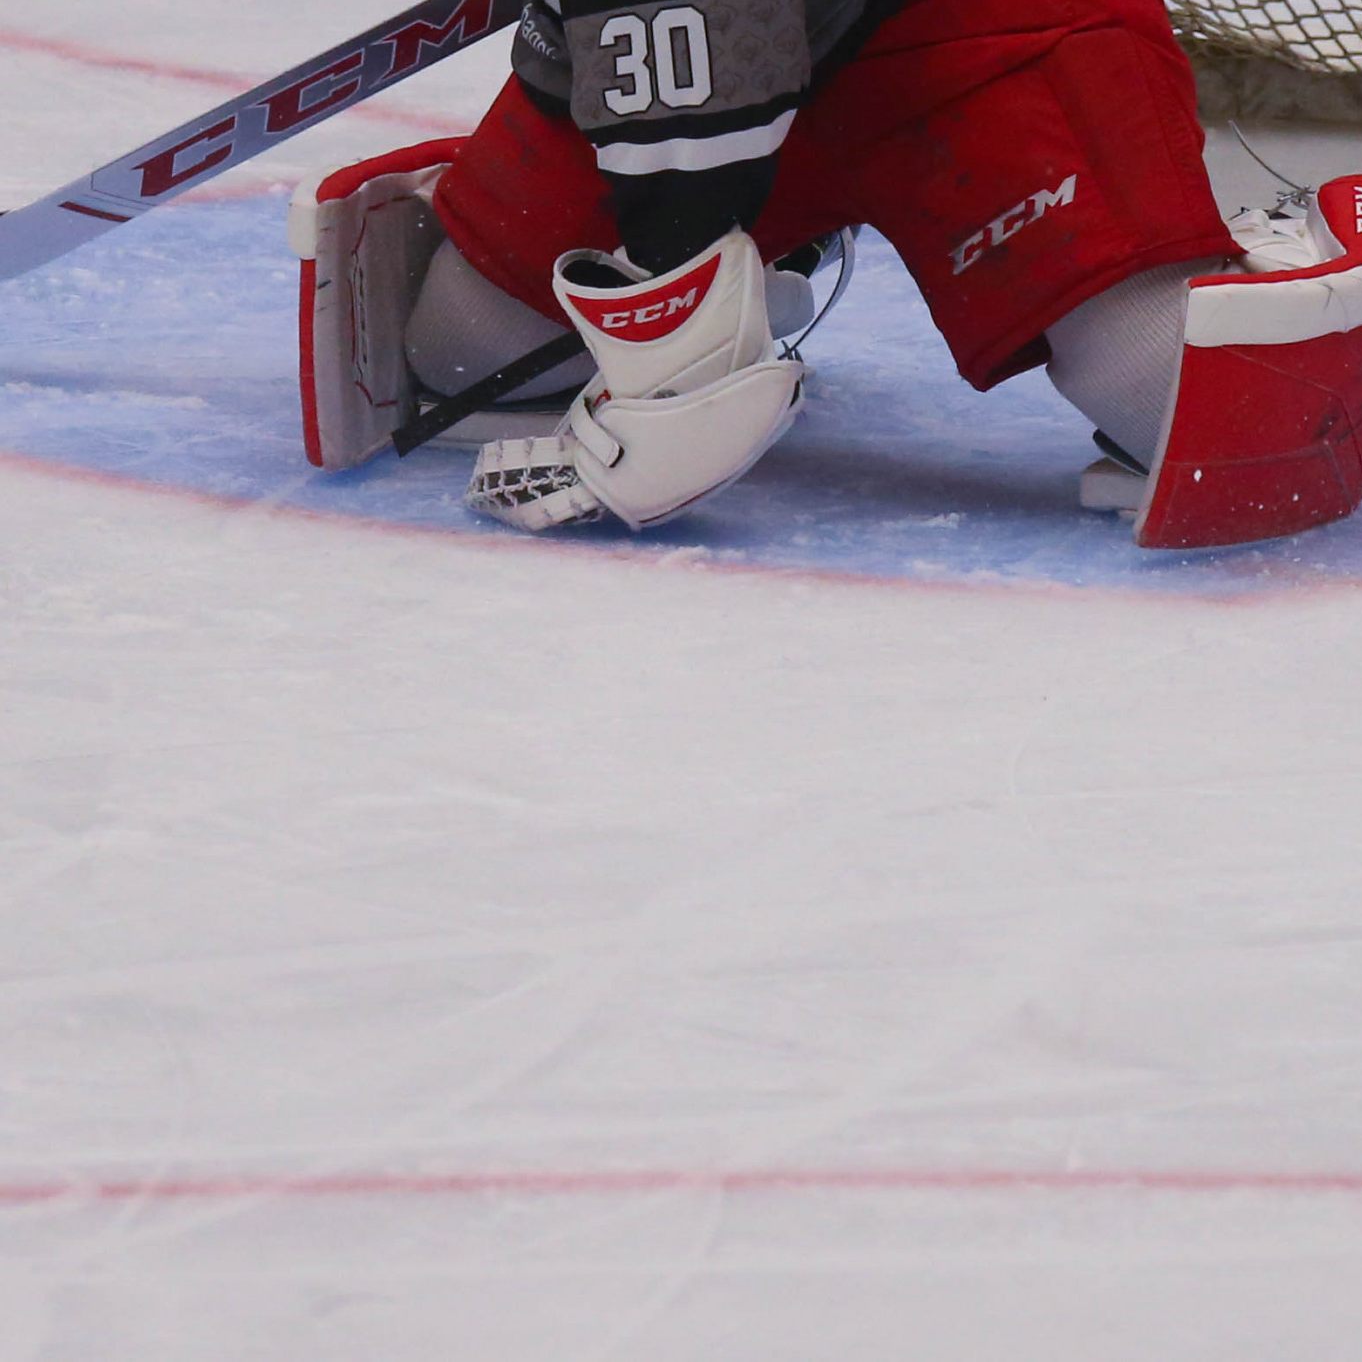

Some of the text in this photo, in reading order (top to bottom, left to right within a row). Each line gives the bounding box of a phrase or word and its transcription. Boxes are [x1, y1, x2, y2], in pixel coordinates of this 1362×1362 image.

[599, 4, 712, 117] 30
[950, 173, 1077, 275] CCM
[601, 287, 698, 331] CCM
